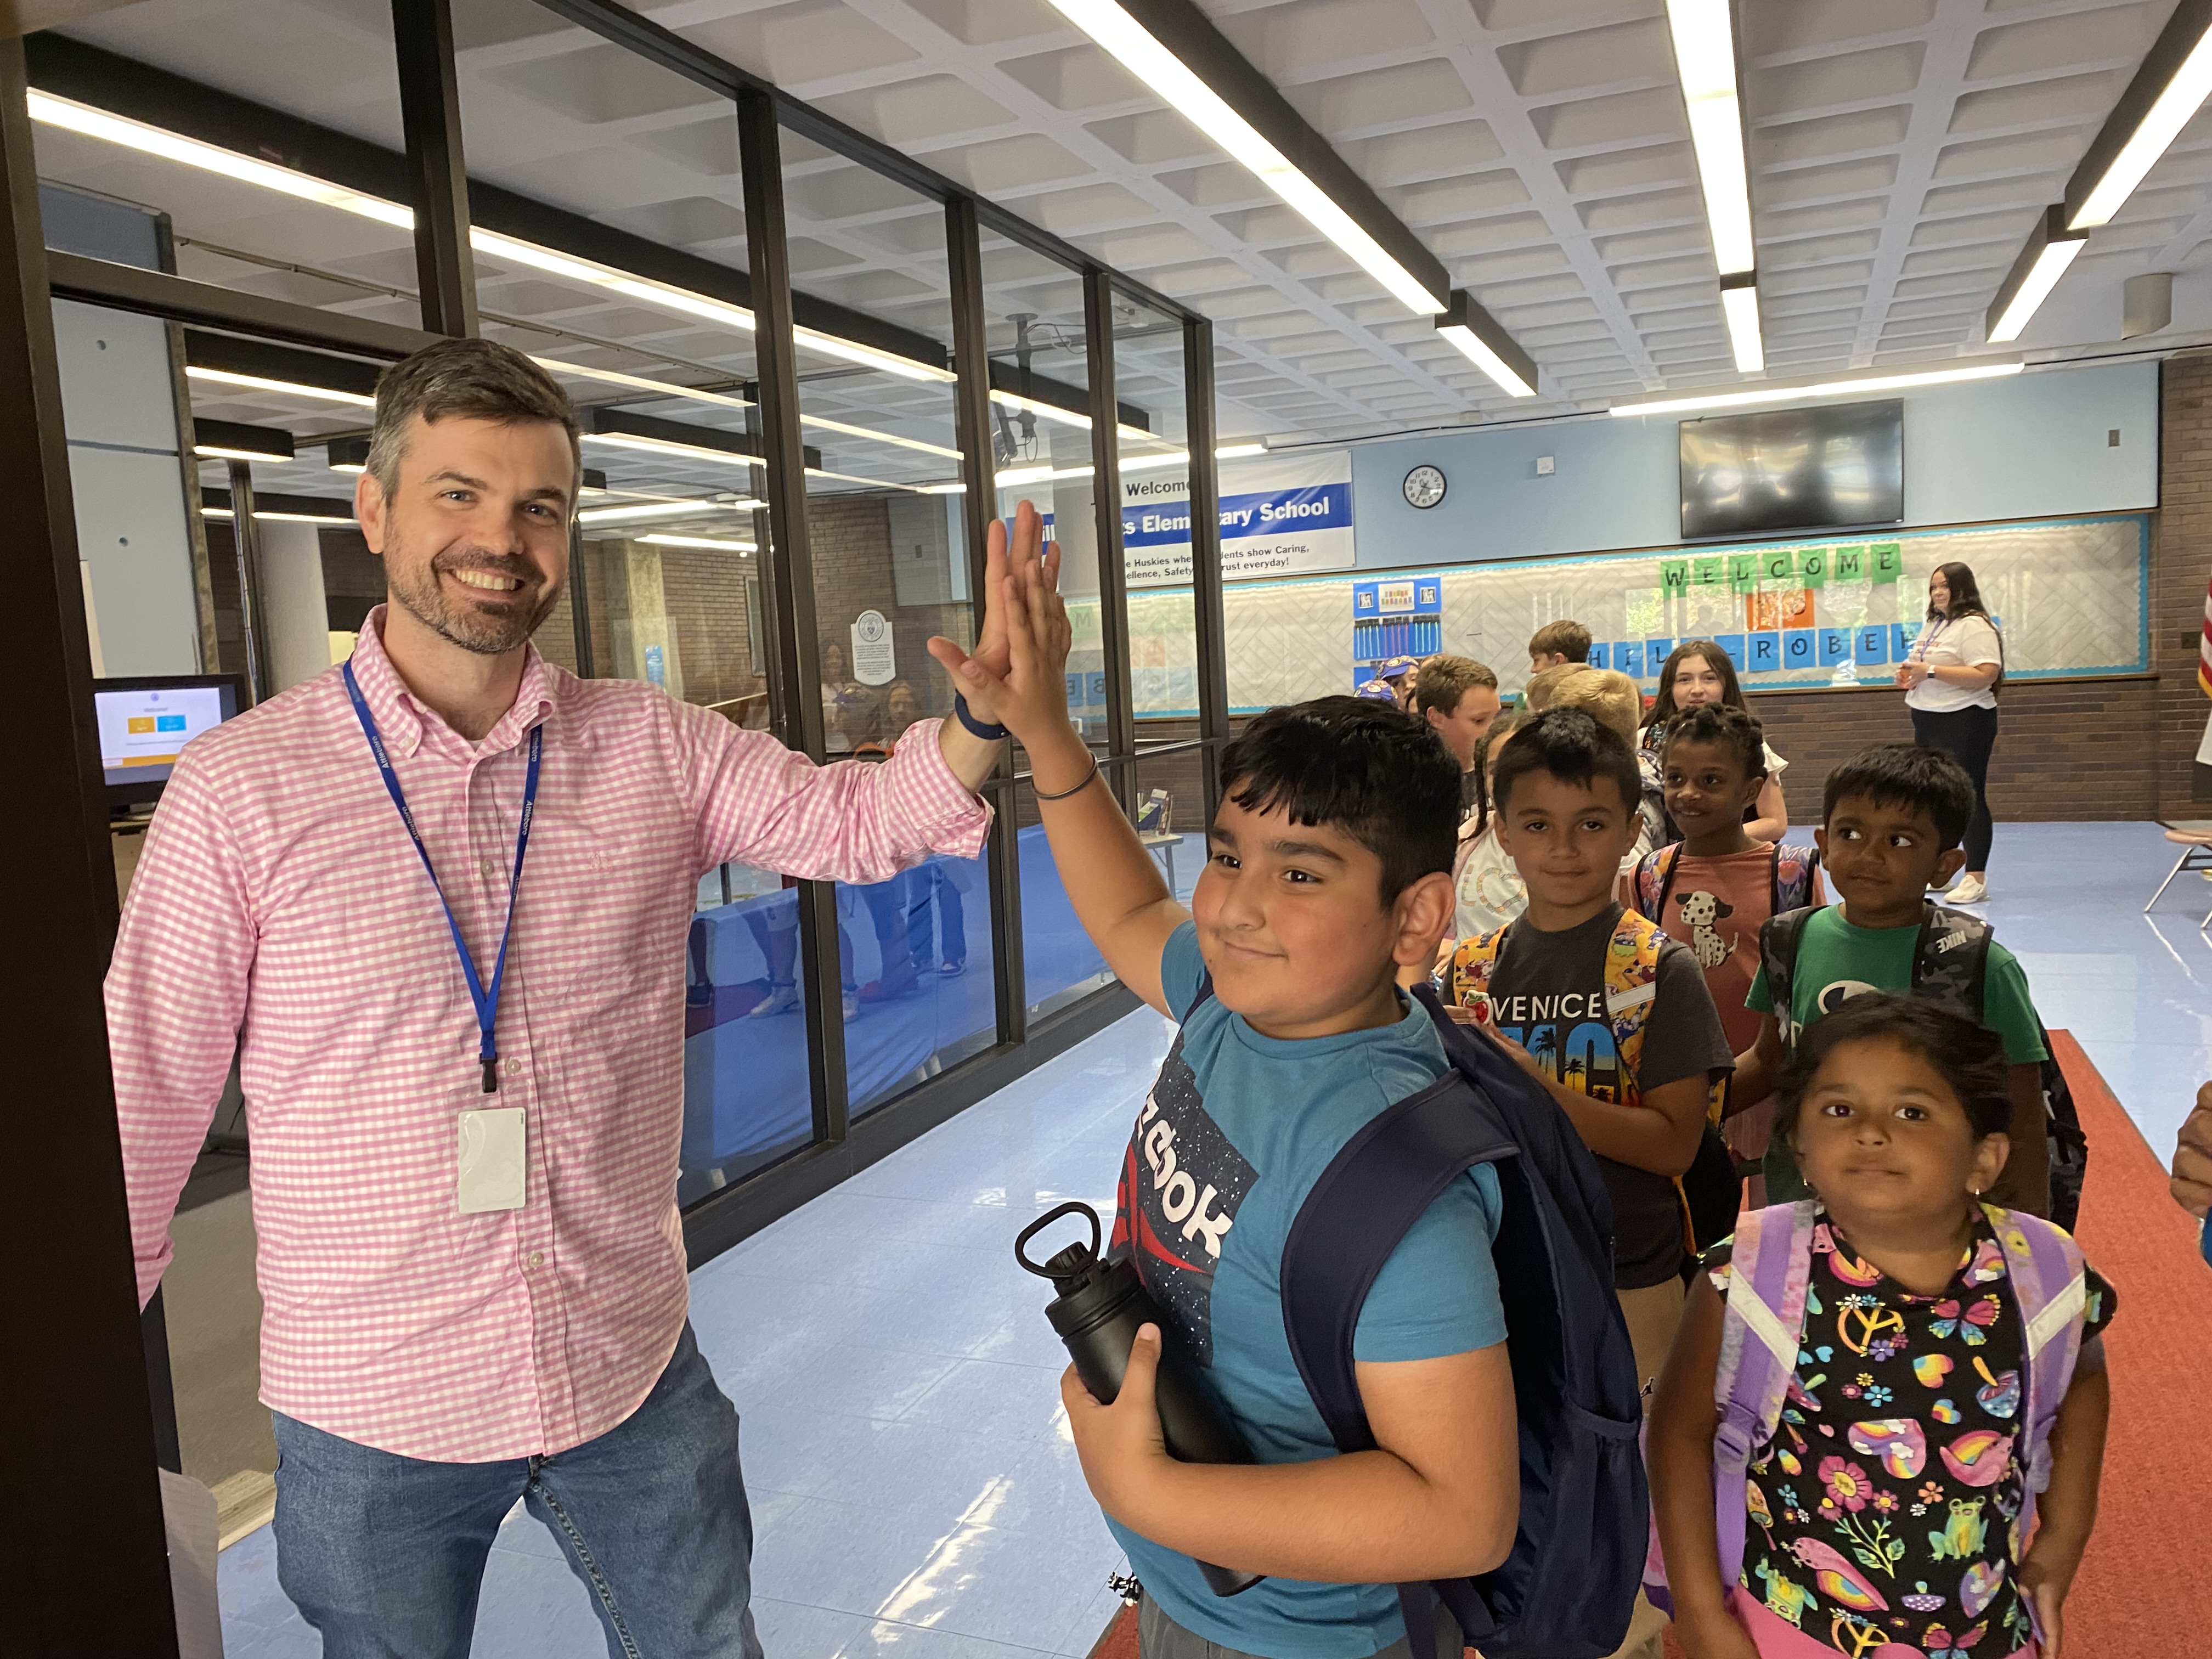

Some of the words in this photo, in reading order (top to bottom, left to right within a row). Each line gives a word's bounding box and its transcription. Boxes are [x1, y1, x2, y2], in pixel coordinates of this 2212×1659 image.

[1260, 496, 1329, 521] School
[1135, 557, 1170, 567] Huskies
[1248, 549, 1272, 557] show
[1276, 545, 1310, 554] Caring,
[1244, 557, 1289, 569] everyday!
[1666, 552, 1893, 586] WELCOME
[522, 799, 533, 836] Attleboro
[1936, 930, 1967, 954] NIKE
[1492, 992, 1602, 1022] VENICE
